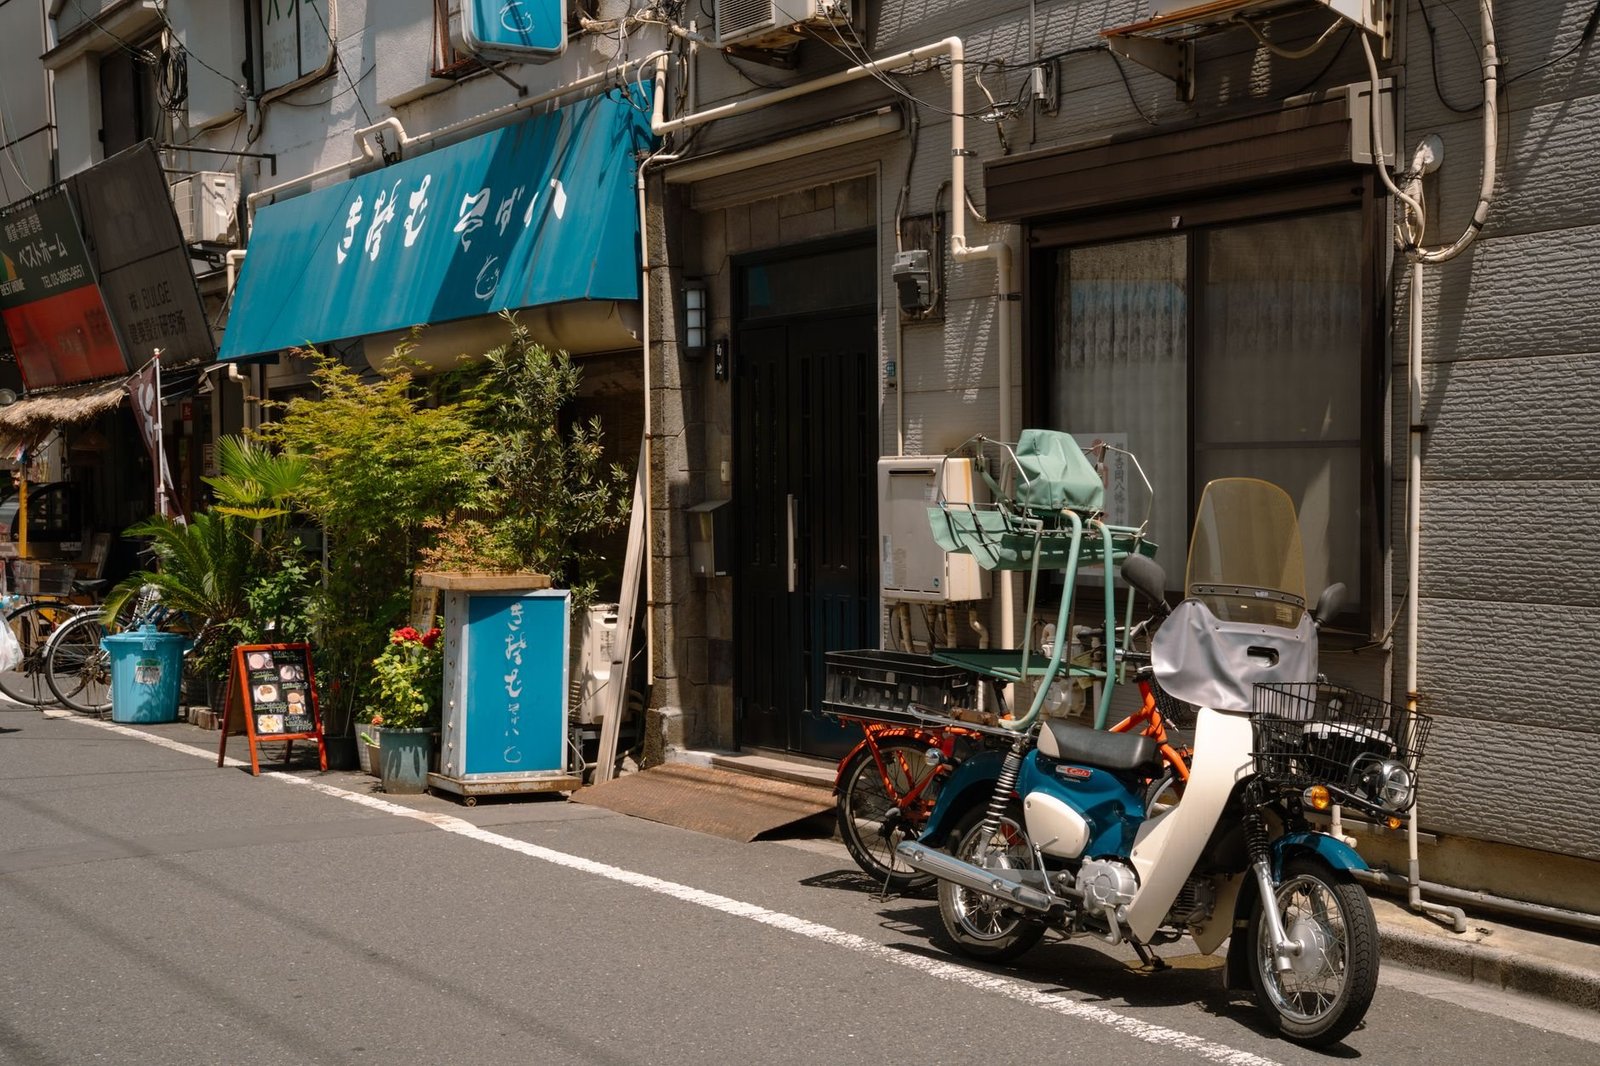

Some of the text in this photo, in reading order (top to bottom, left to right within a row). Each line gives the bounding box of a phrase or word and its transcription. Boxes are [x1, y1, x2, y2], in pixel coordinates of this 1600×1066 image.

[18, 230, 68, 268] ベストホーム
[141, 281, 172, 310] BULGE
